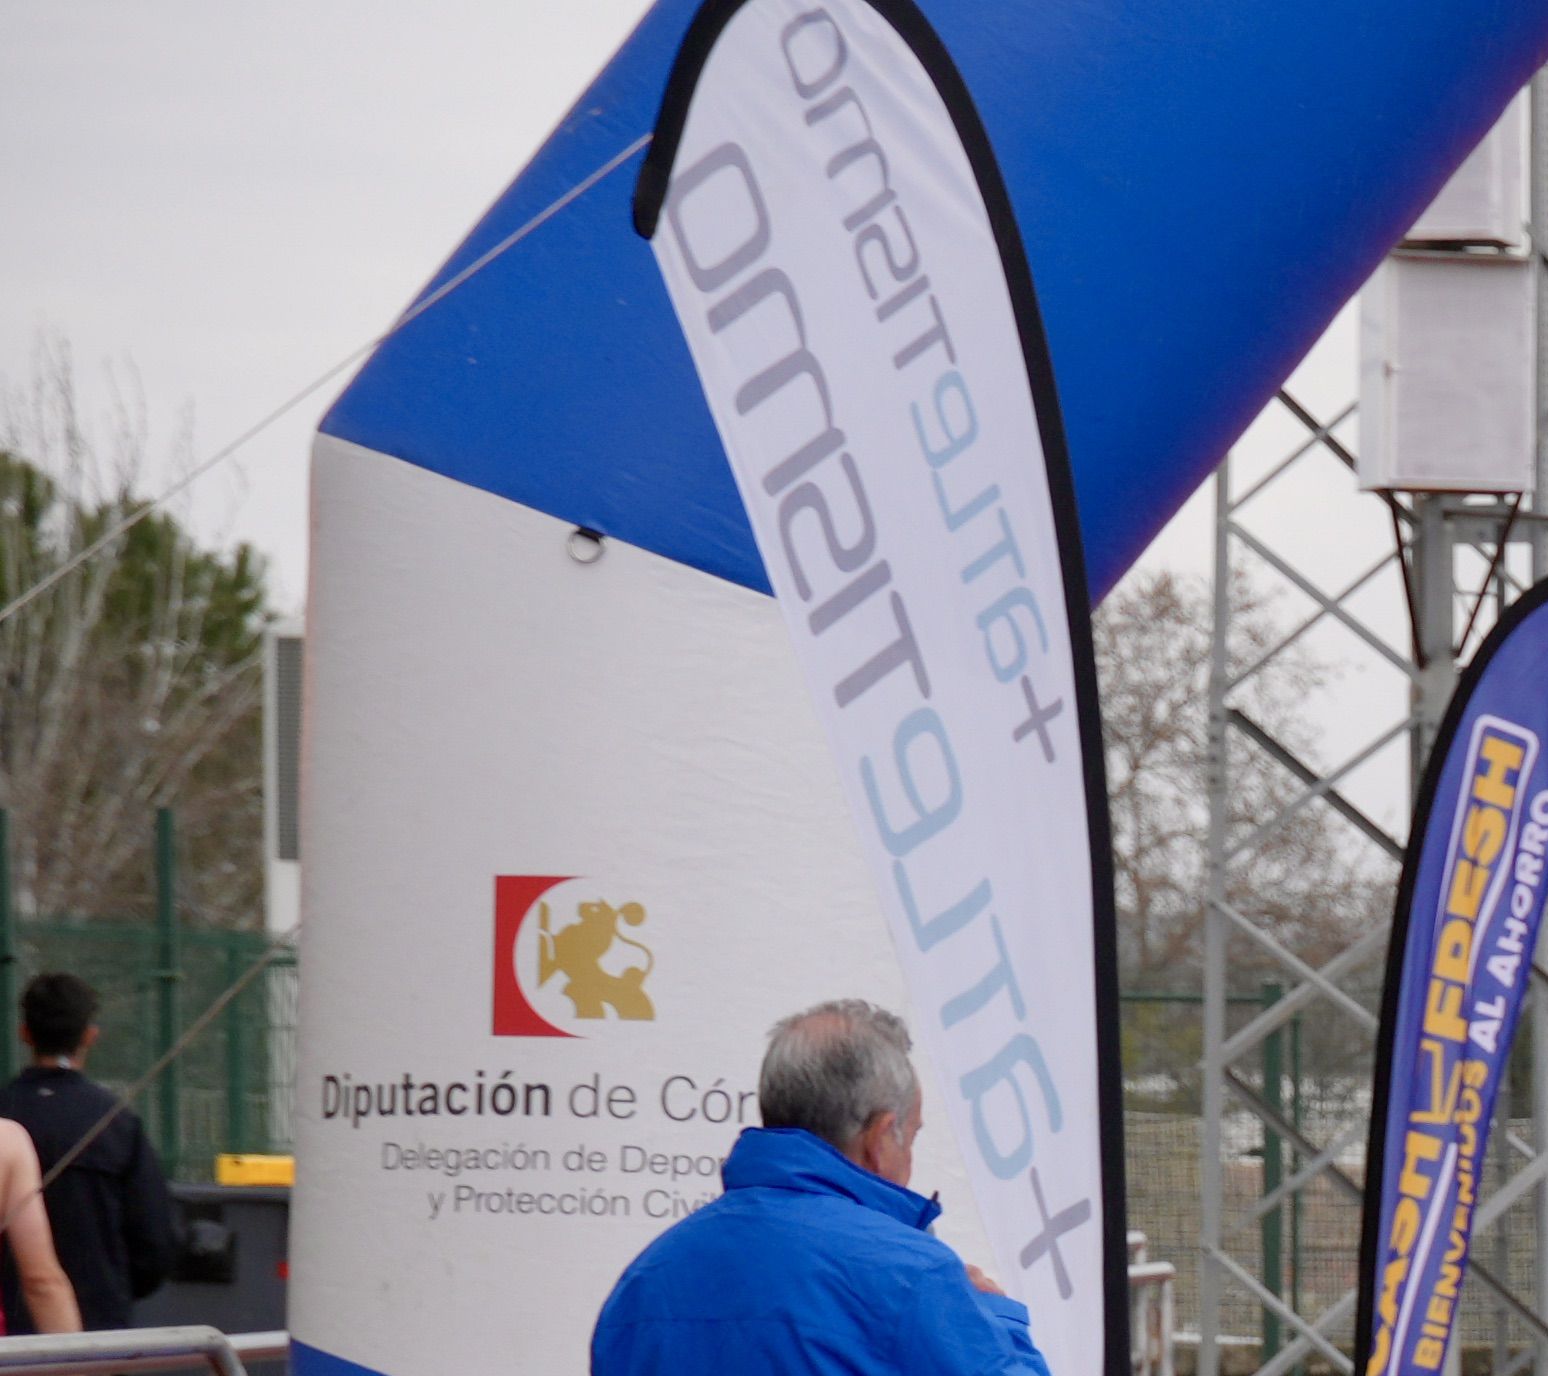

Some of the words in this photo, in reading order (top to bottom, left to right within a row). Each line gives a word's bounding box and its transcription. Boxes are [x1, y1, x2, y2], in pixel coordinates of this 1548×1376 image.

[1468, 994, 1505, 1055] AL
[321, 1070, 551, 1129] Diputación
[568, 1072, 638, 1119] de
[381, 1141, 551, 1179] Delegación
[562, 1144, 609, 1174] de
[427, 1191, 446, 1221] y
[454, 1184, 631, 1217] Protección
